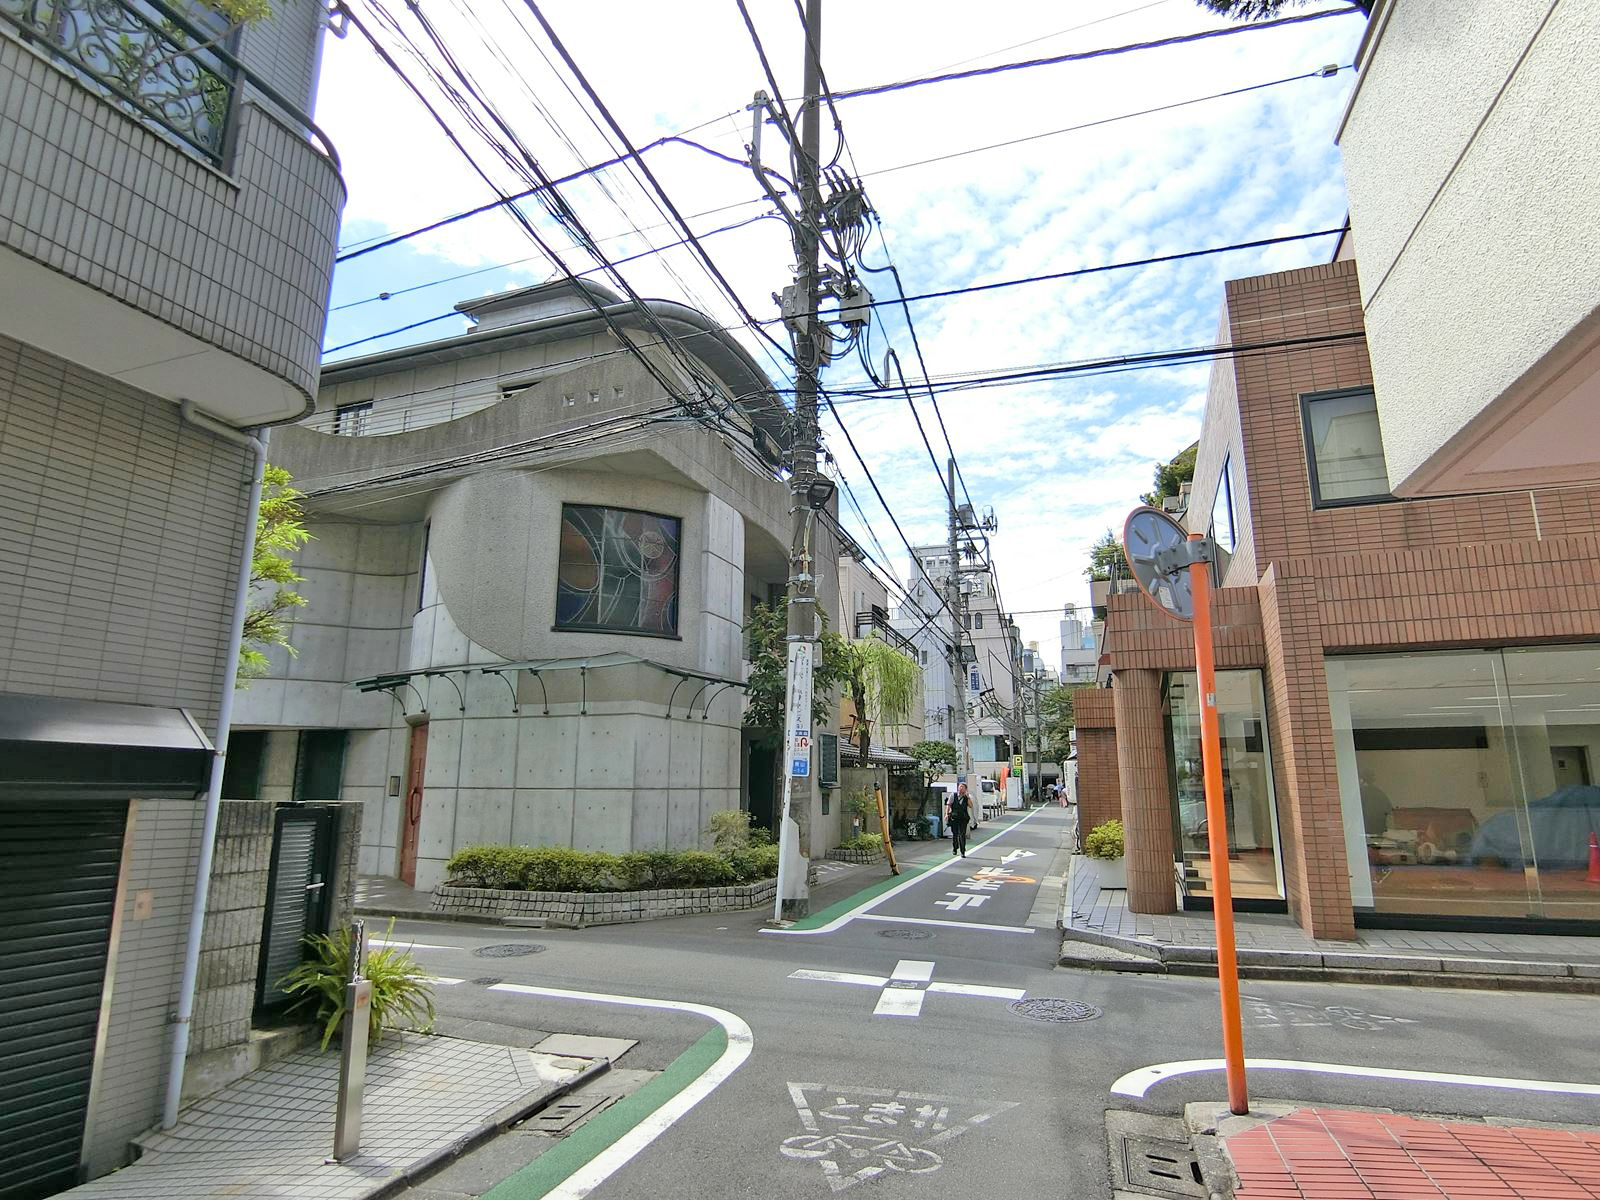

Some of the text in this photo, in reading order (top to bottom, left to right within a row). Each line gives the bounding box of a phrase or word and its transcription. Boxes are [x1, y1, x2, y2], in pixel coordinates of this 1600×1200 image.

[933, 866, 1014, 911] 止まれ
[818, 1097, 949, 1130] とまれ
